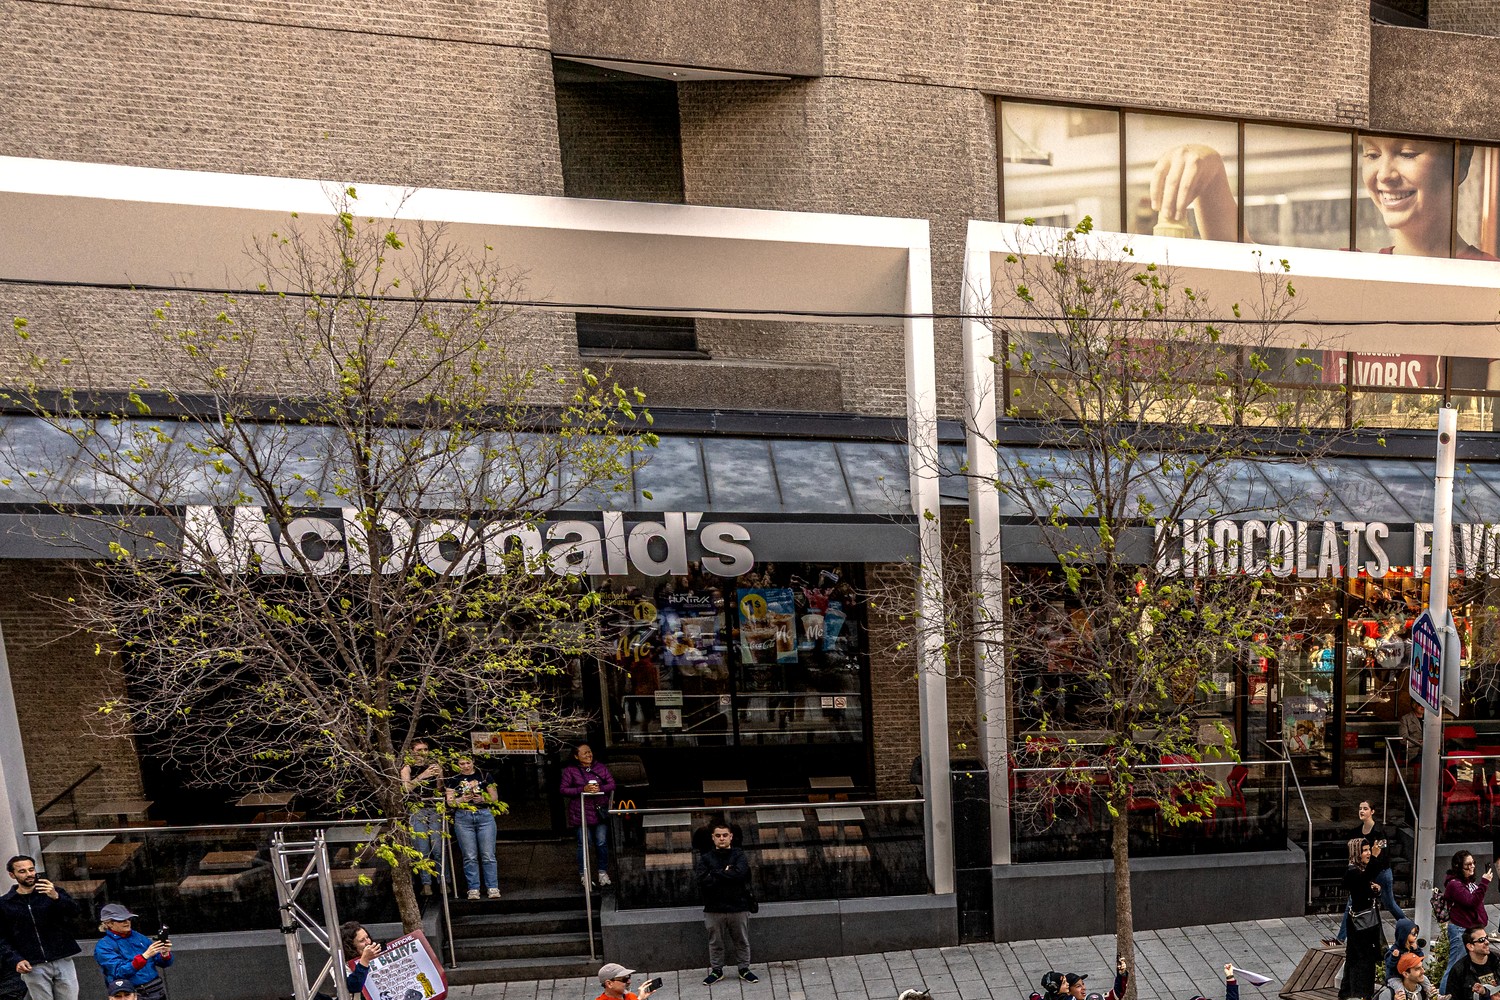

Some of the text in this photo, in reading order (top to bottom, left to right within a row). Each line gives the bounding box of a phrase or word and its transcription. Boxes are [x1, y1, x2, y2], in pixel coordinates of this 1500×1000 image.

[180, 504, 755, 577] McDonald's
[1154, 518, 1390, 579] CHOCOLATS
[378, 941, 419, 966] BELIEVE
